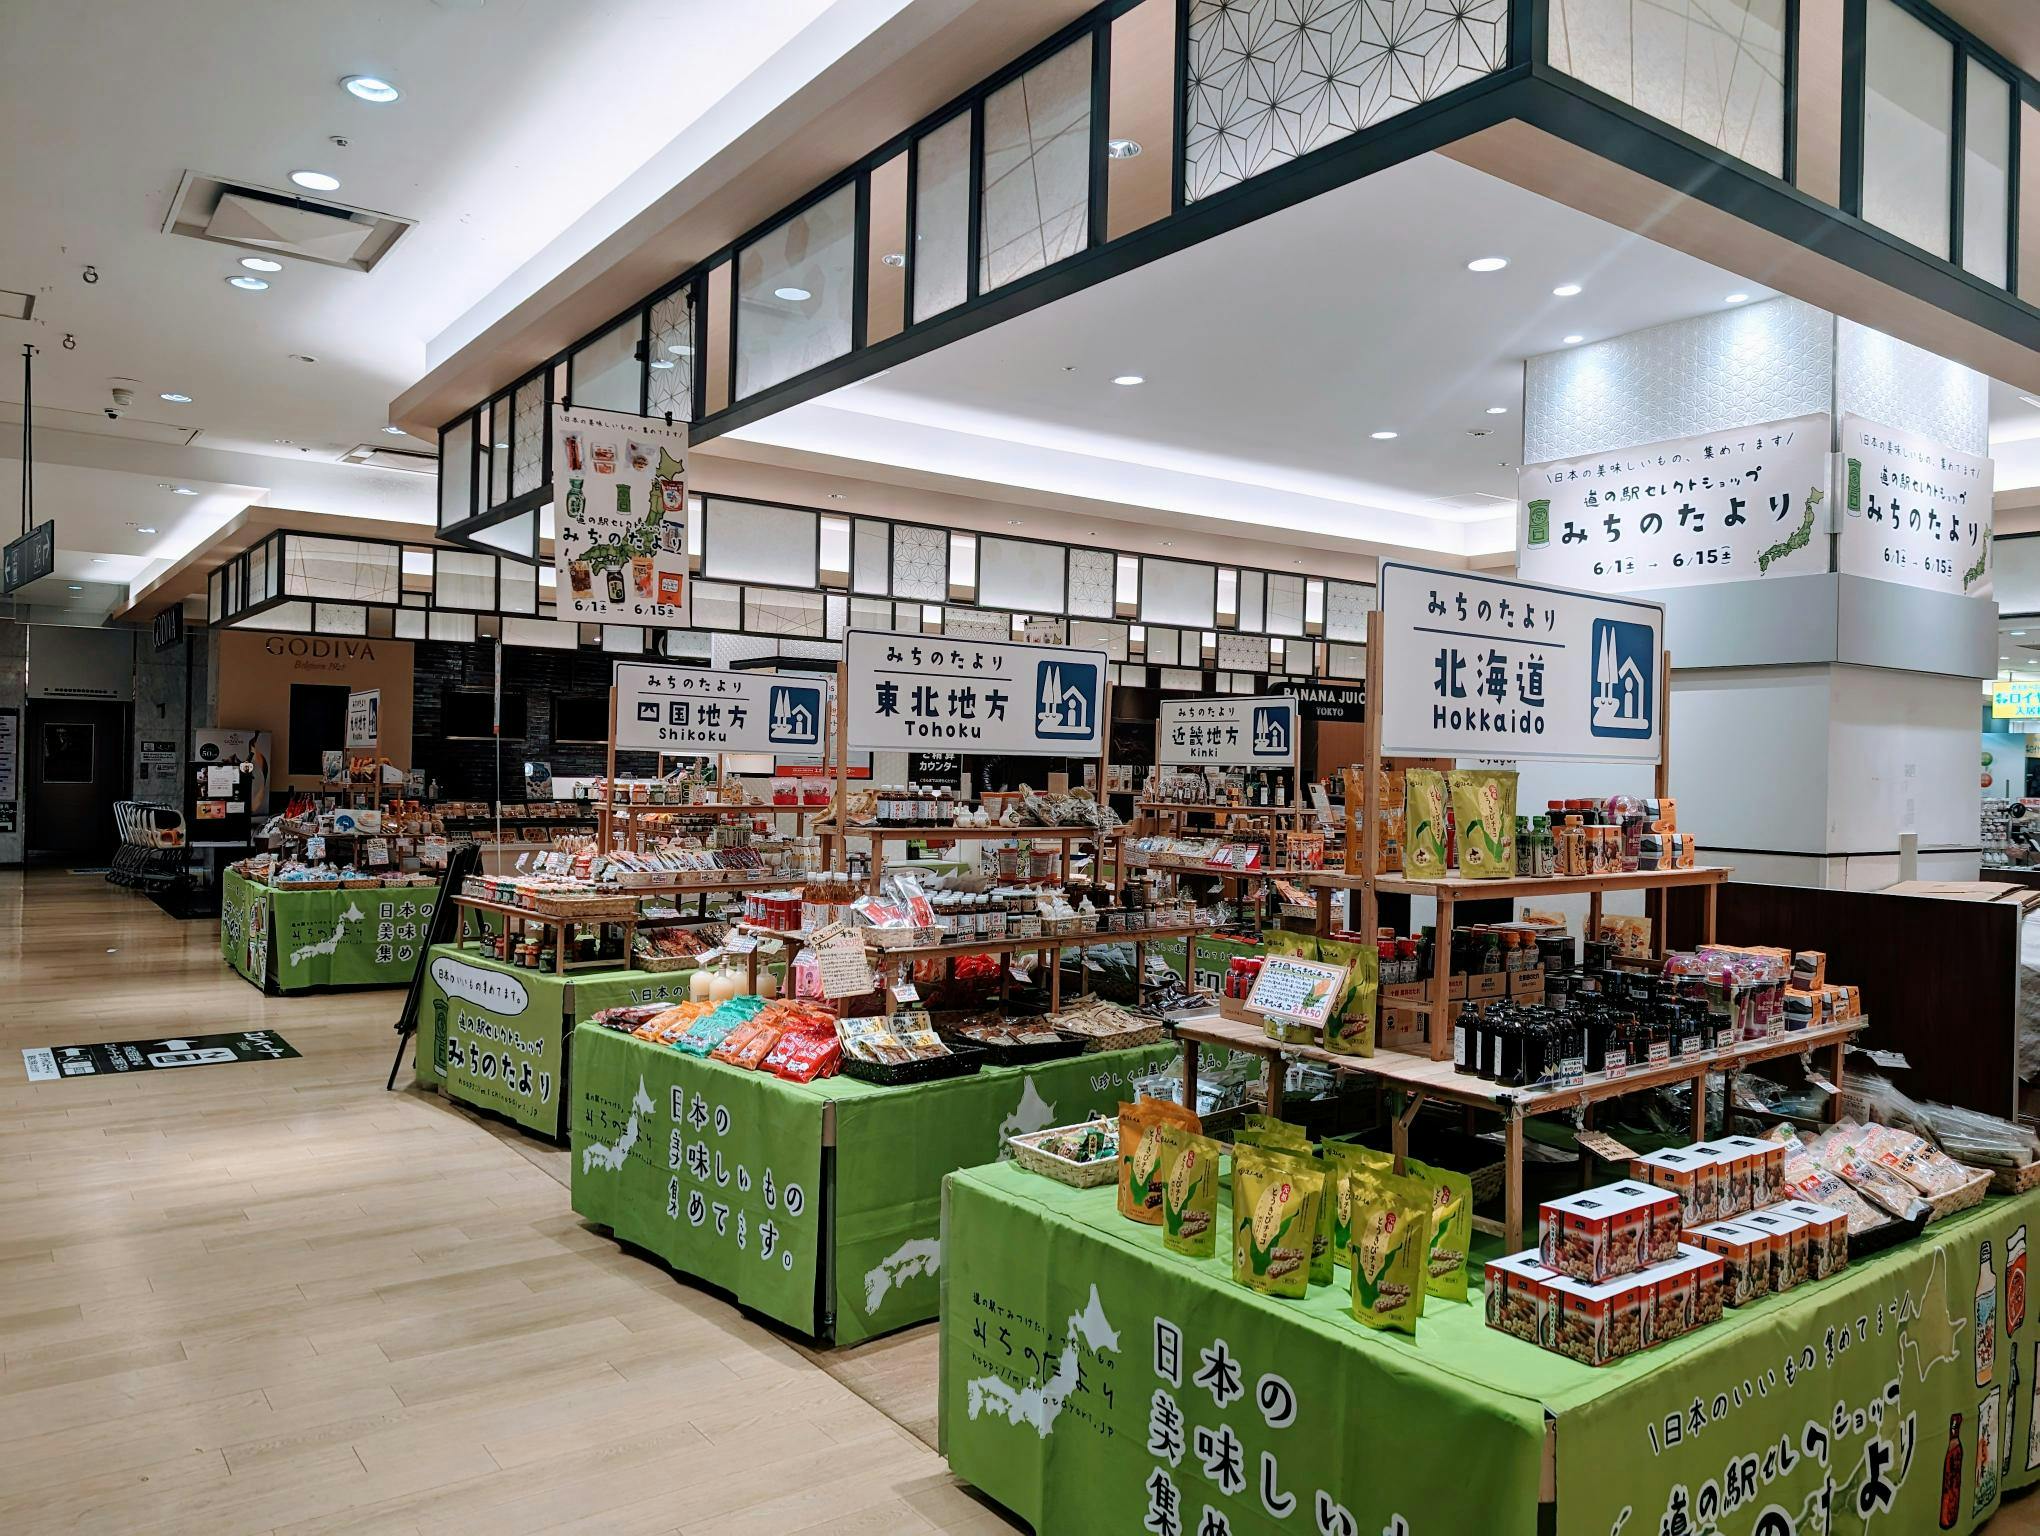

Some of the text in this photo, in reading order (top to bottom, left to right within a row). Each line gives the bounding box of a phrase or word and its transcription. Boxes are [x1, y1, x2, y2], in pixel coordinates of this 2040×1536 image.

[1583, 465, 1761, 508] 道の駅セレクトショップ
[1880, 467, 1967, 506] 道の駅セレクトショップ
[1562, 492, 1791, 545] みちのたより
[1868, 494, 1978, 546] みちのたより
[563, 527, 682, 550] みちのたより
[1428, 590, 1556, 632] みちのたより
[266, 636, 375, 661] GODIVA
[886, 646, 1004, 670] みちのたより
[647, 675, 743, 694] みちのたより
[1433, 648, 1545, 708] 北海道
[874, 680, 1010, 721] 東北地方
[1284, 688, 1336, 702] BANANA
[637, 701, 748, 730] 四国地方
[1178, 706, 1236, 719] みちのたより
[1316, 706, 1344, 717] TOKYO
[1434, 705, 1545, 736] Hokkaido
[658, 726, 727, 744] Shikoku
[905, 720, 982, 740] Tohoku
[1172, 725, 1239, 747] 近畿地方
[919, 761, 959, 773] カウンター
[1190, 747, 1218, 758] Kinki
[381, 902, 433, 918] 日本の
[448, 1039, 551, 1103] みちのたより
[672, 1088, 730, 1133] 日本の
[672, 1131, 804, 1215] 美味しいもの
[973, 1318, 1113, 1410] みちのたより
[1157, 1322, 1293, 1423] 日本の
